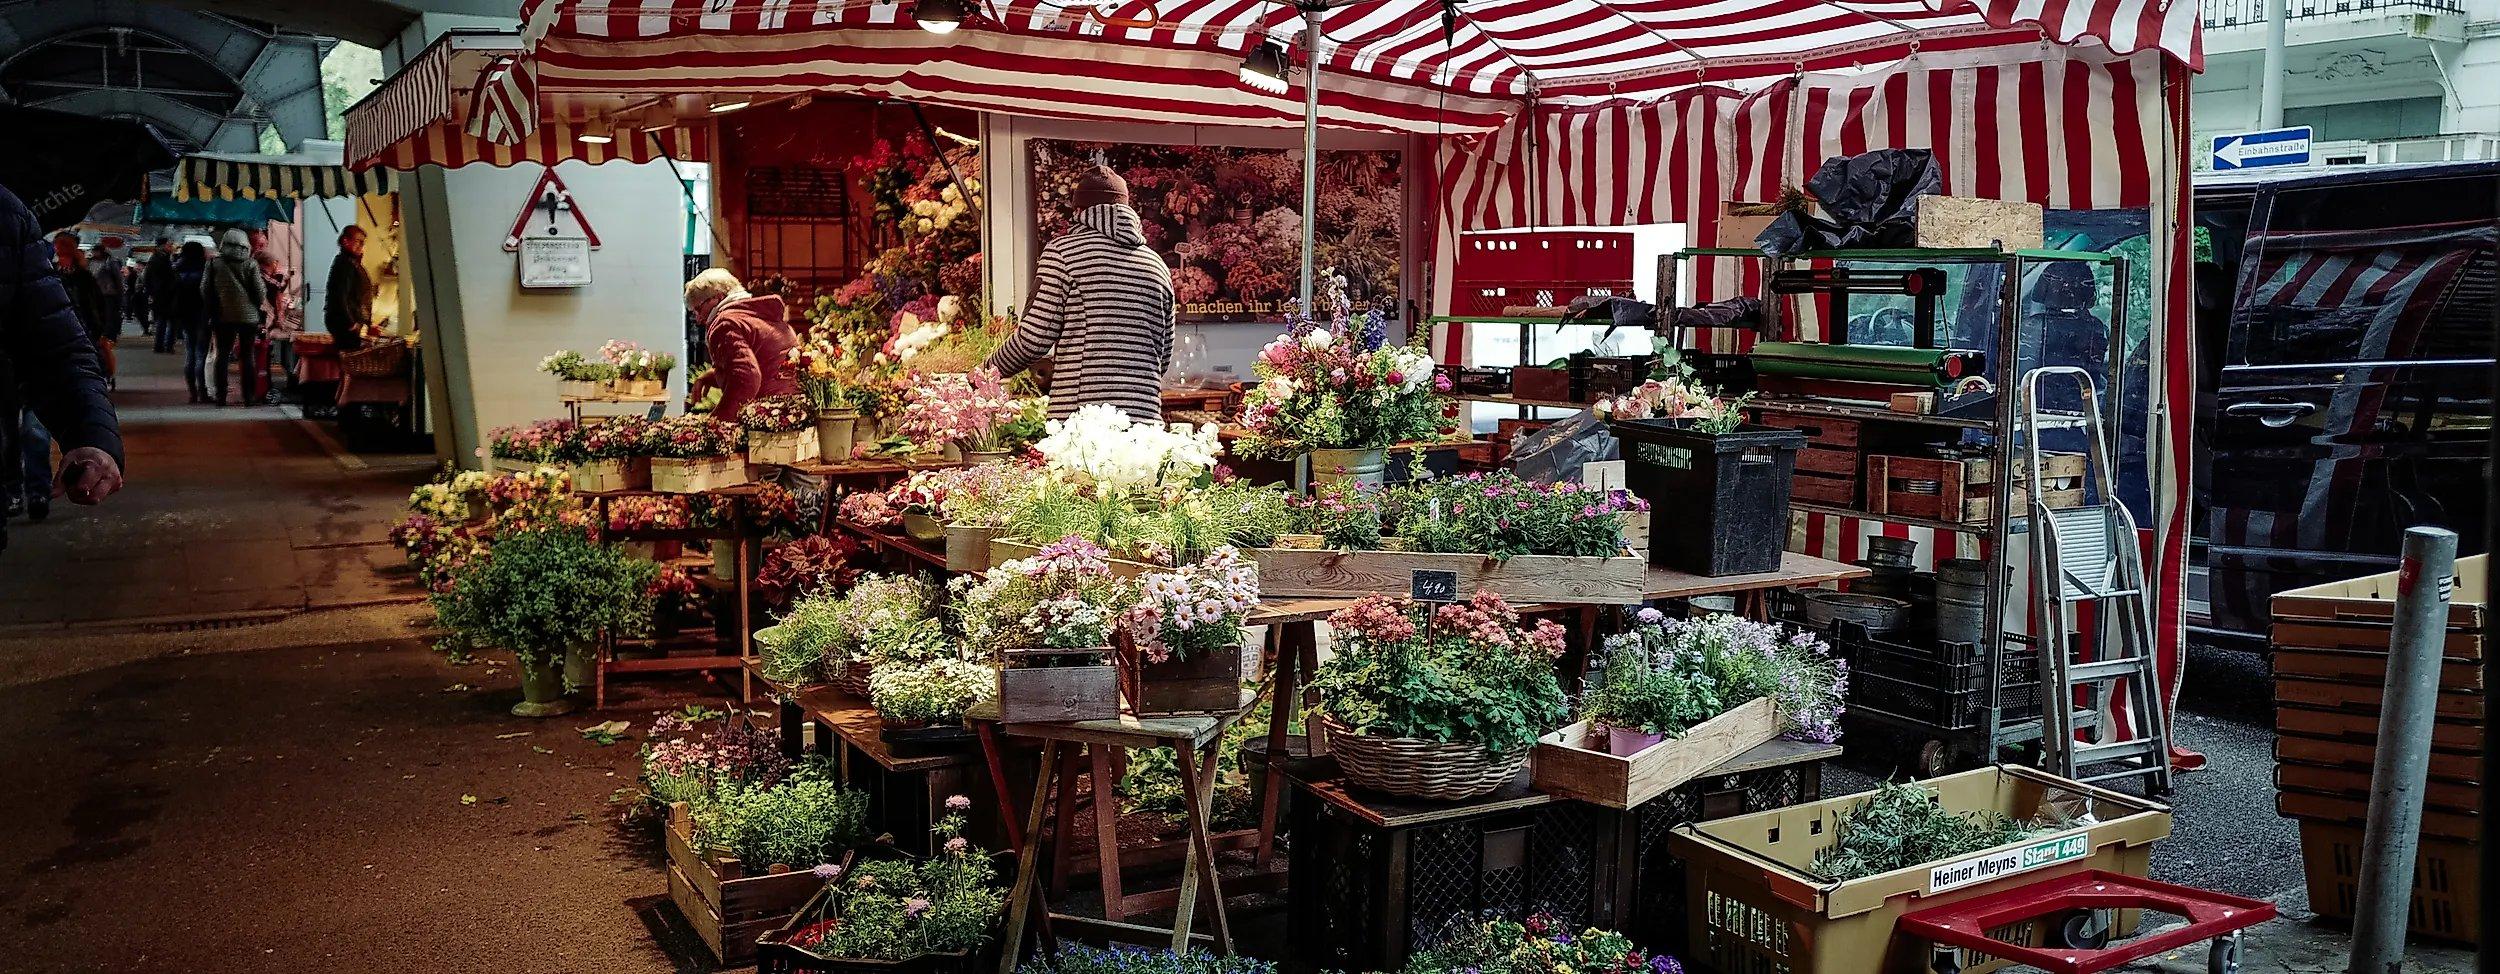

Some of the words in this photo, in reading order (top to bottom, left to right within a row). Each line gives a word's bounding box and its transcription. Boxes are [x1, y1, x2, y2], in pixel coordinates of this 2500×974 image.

[2239, 142, 2305, 156] Einbahnstraße
[1185, 300, 1244, 314] machen
[1248, 299, 1272, 312] ihr
[1933, 865, 1974, 887] Heiner
[1978, 855, 2017, 878] Meyns
[2024, 842, 2060, 865] Stand
[2062, 837, 2085, 856] 449
